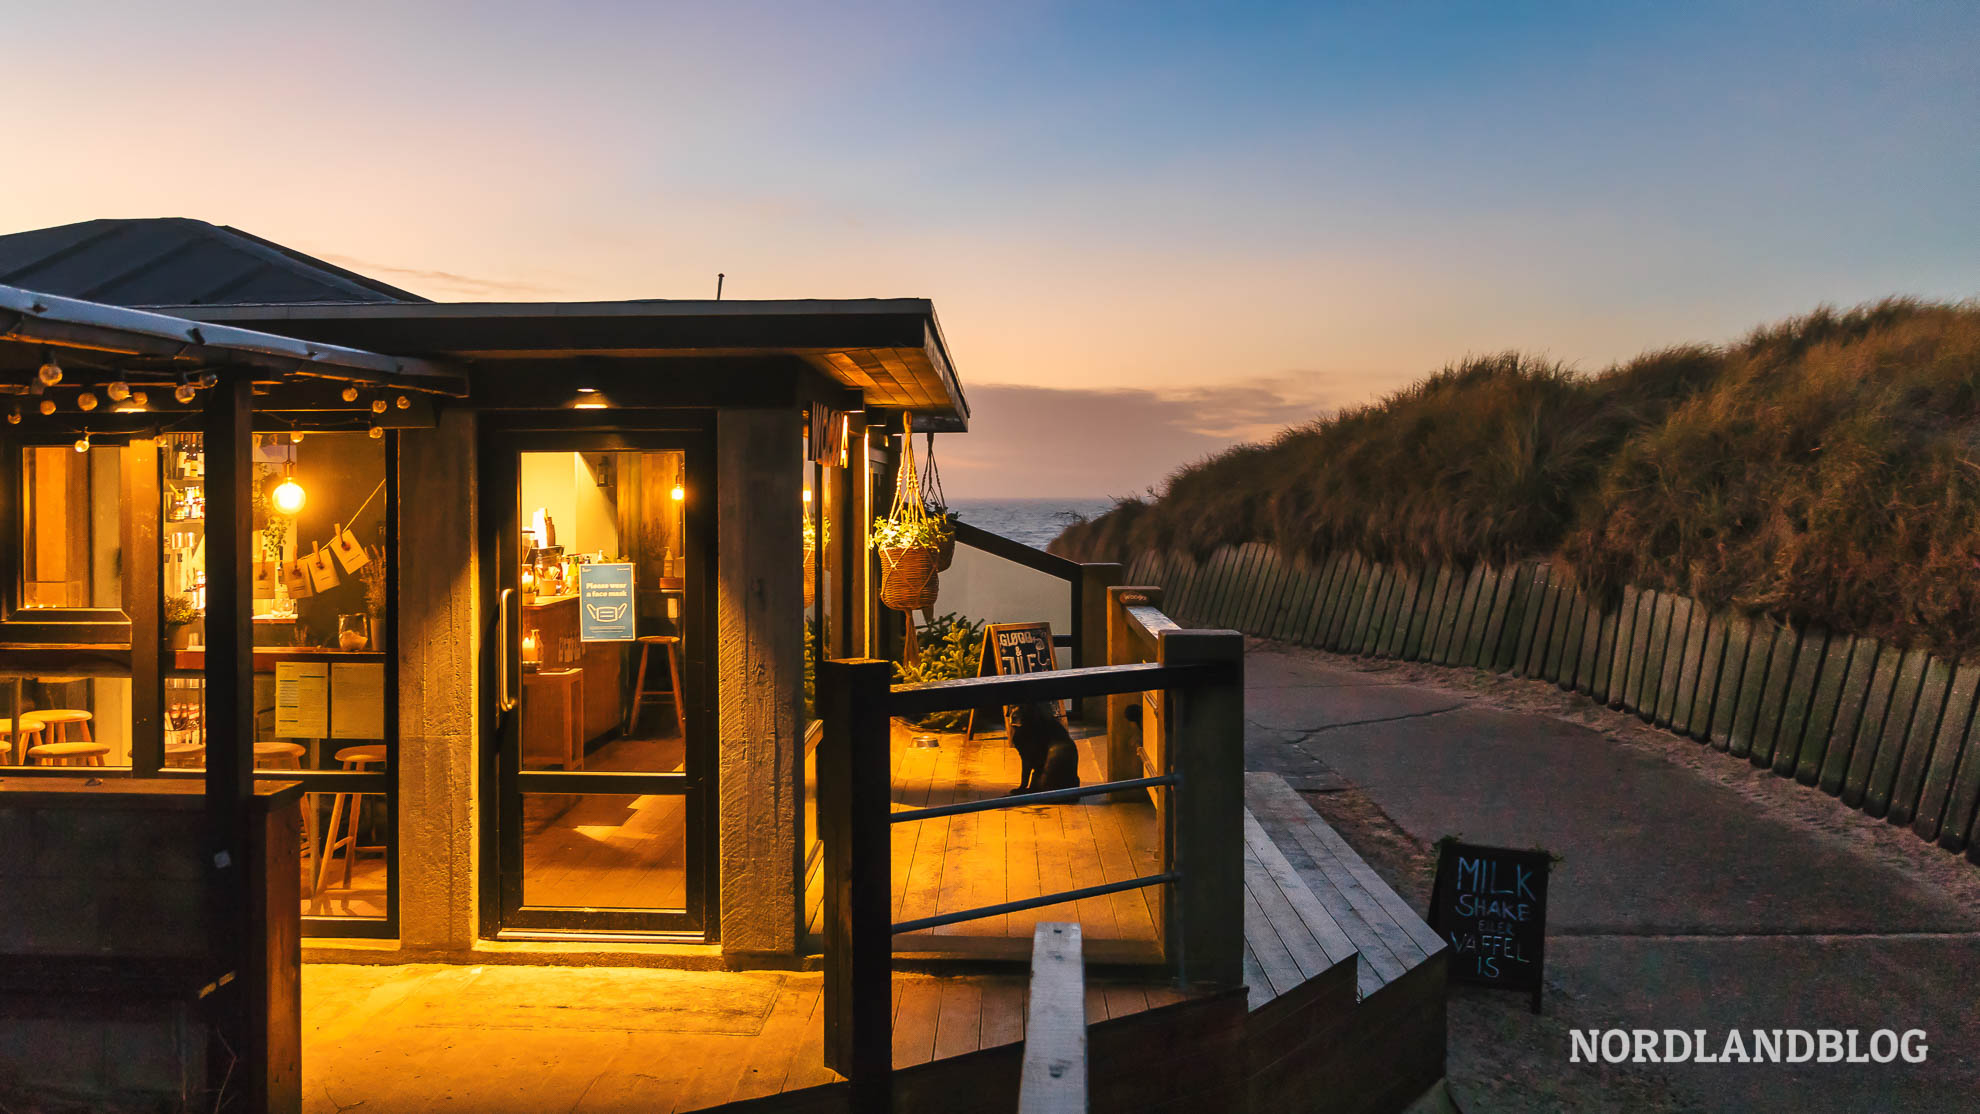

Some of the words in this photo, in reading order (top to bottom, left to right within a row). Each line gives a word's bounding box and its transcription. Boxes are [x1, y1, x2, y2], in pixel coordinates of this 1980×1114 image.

[585, 582, 609, 590] Please
[591, 590, 608, 598] face
[1015, 645, 1022, 657] &
[1457, 856, 1537, 901] MILK
[1455, 893, 1530, 921] SHAKE
[1449, 930, 1531, 963] VAFFEL
[1476, 955, 1500, 978] IS
